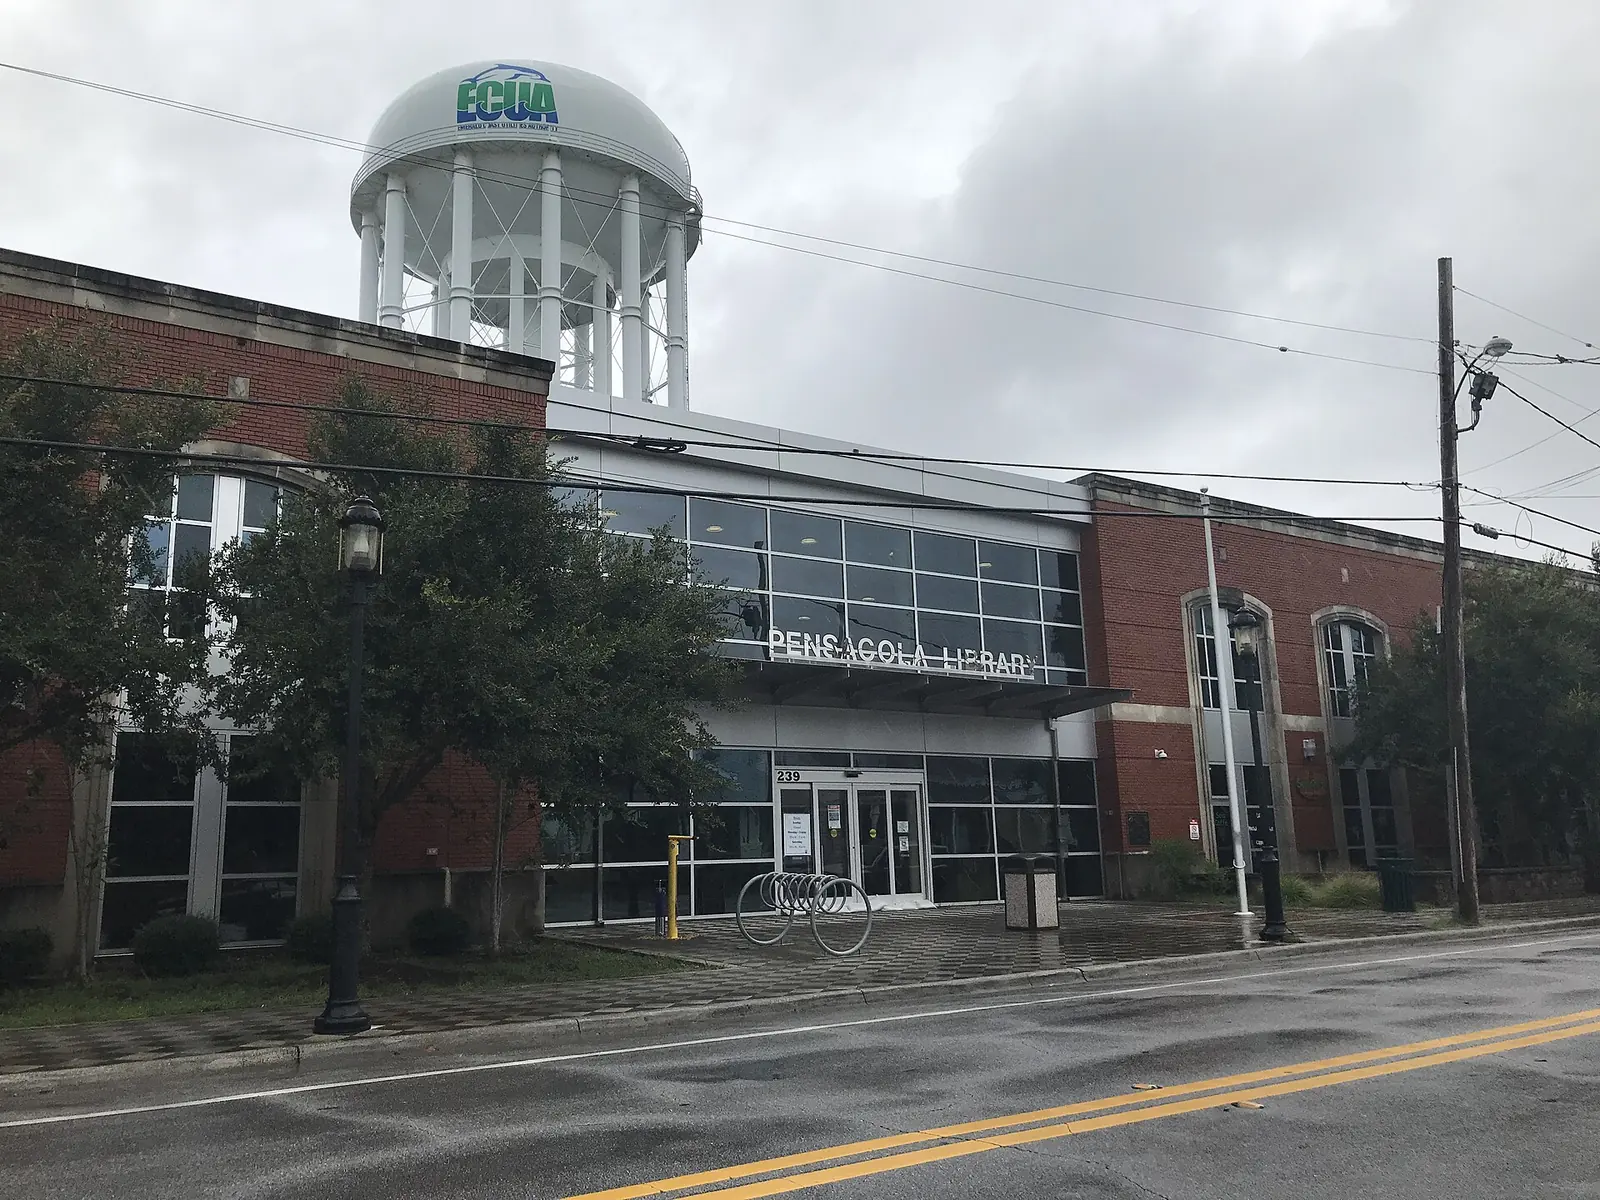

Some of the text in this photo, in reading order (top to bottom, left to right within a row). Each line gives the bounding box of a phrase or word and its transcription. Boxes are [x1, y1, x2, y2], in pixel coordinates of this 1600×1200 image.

[457, 80, 559, 123] ECUA
[769, 629, 928, 668] PENSACOLA
[777, 770, 801, 782] 239
